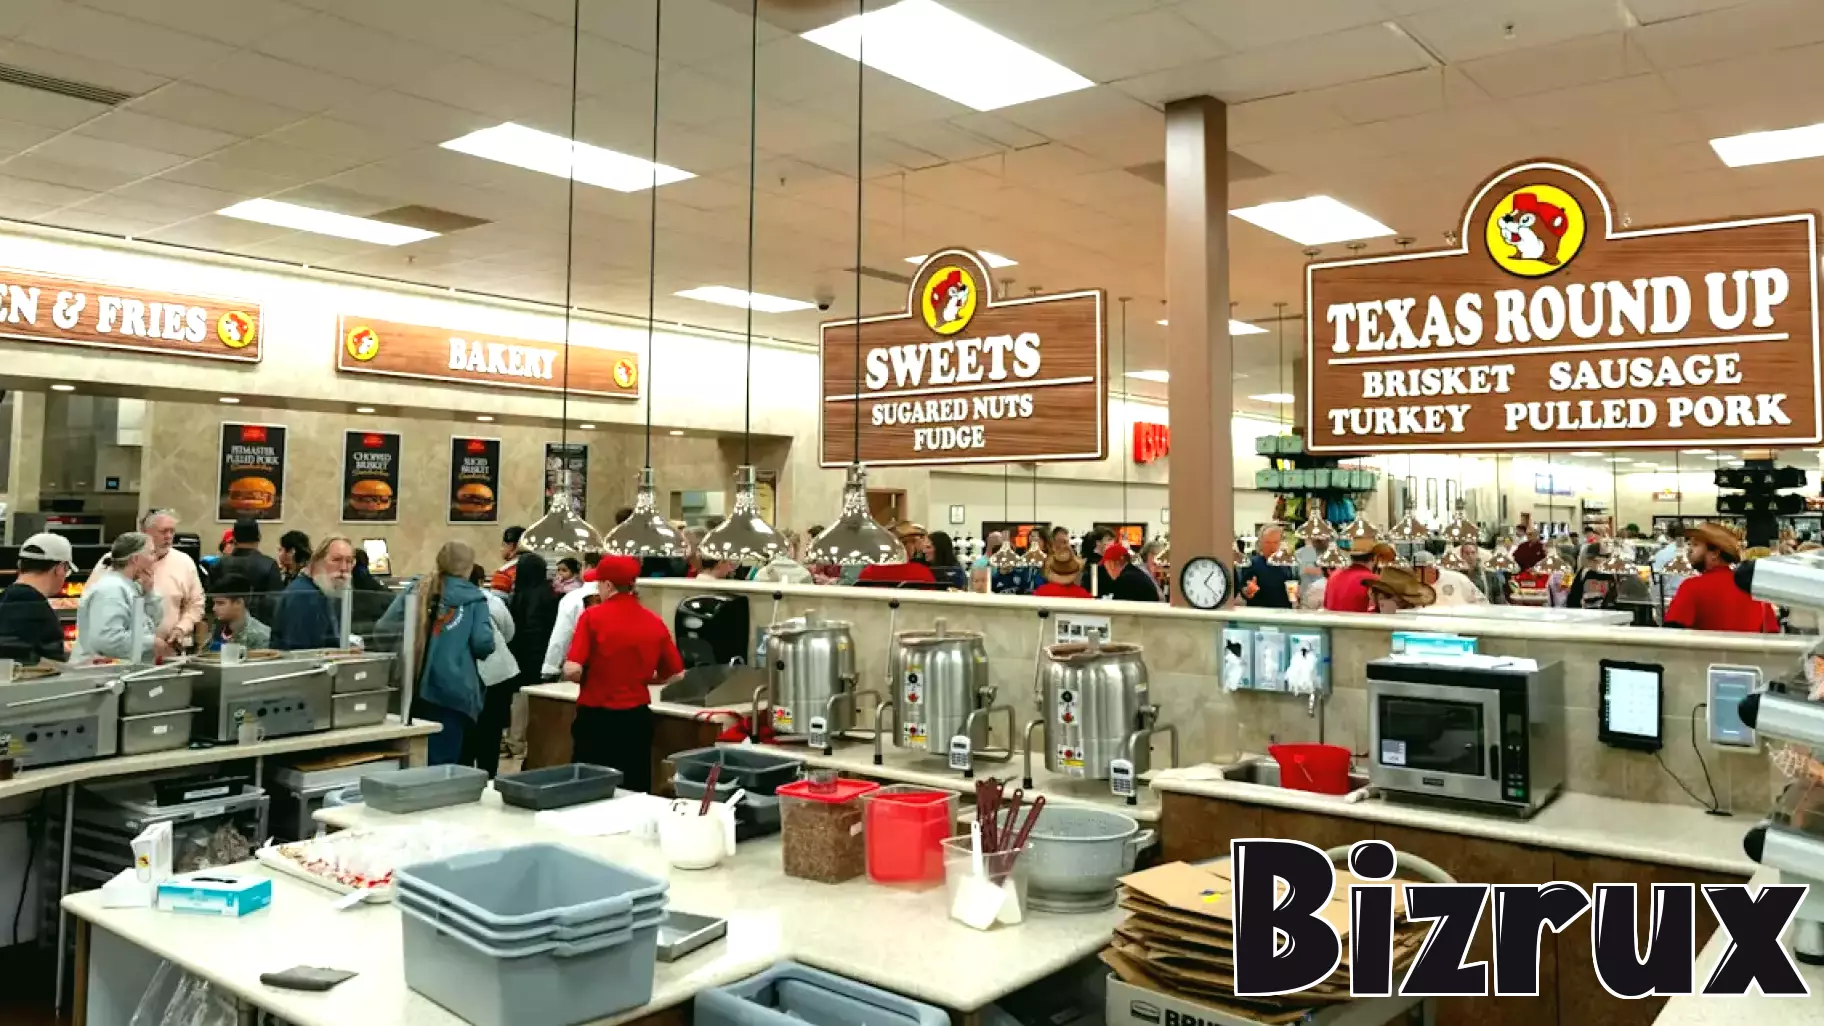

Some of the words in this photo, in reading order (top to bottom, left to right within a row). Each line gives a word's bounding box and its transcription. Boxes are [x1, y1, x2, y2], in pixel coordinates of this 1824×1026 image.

[53, 290, 86, 329] &
[96, 296, 208, 342] FRIES
[1326, 291, 1483, 353] TEXAS
[1494, 276, 1692, 344] ROUND
[1704, 267, 1790, 330] UP
[449, 337, 559, 379] BAKERY
[865, 332, 1041, 390] SWEETS
[1362, 364, 1515, 398] BRISKET
[1548, 352, 1743, 391] SAUSAGE
[871, 398, 969, 426] SUGARED
[972, 393, 1033, 420] NUTS
[1328, 404, 1472, 435] TURKEY
[1504, 398, 1657, 431] PULLED
[1666, 393, 1791, 427] PORK
[913, 425, 985, 450] FUDGE
